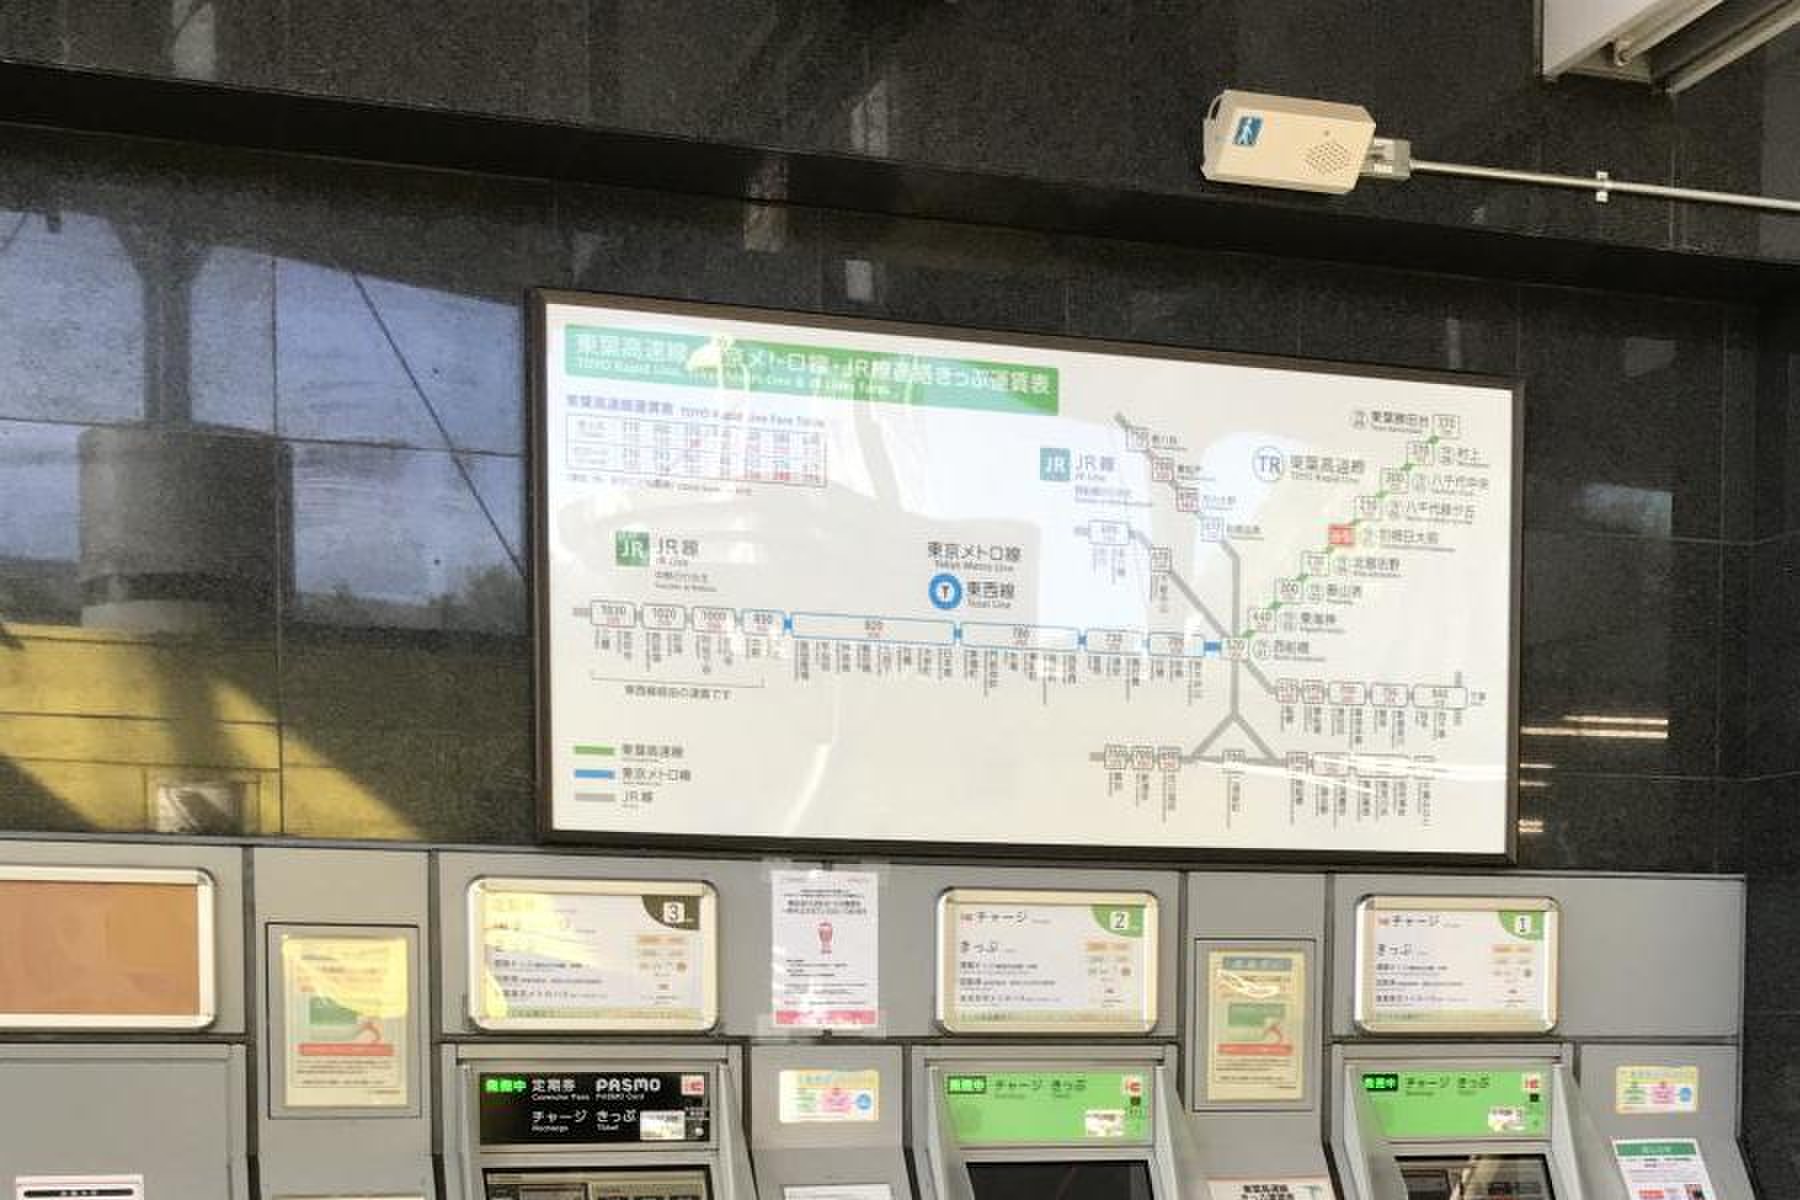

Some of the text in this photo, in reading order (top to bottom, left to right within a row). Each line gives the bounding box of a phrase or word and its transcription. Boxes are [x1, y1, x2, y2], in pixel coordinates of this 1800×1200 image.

[1046, 456, 1067, 474] JR
[624, 542, 645, 560] JR
[928, 541, 1021, 563] 東京メトロ線
[967, 581, 1015, 600] 東西線
[669, 903, 681, 922] 3
[1113, 912, 1126, 929] 2
[595, 1077, 661, 1093] PASMO
[531, 1109, 588, 1123] チャージ
[596, 1109, 637, 1123] きっぷ
